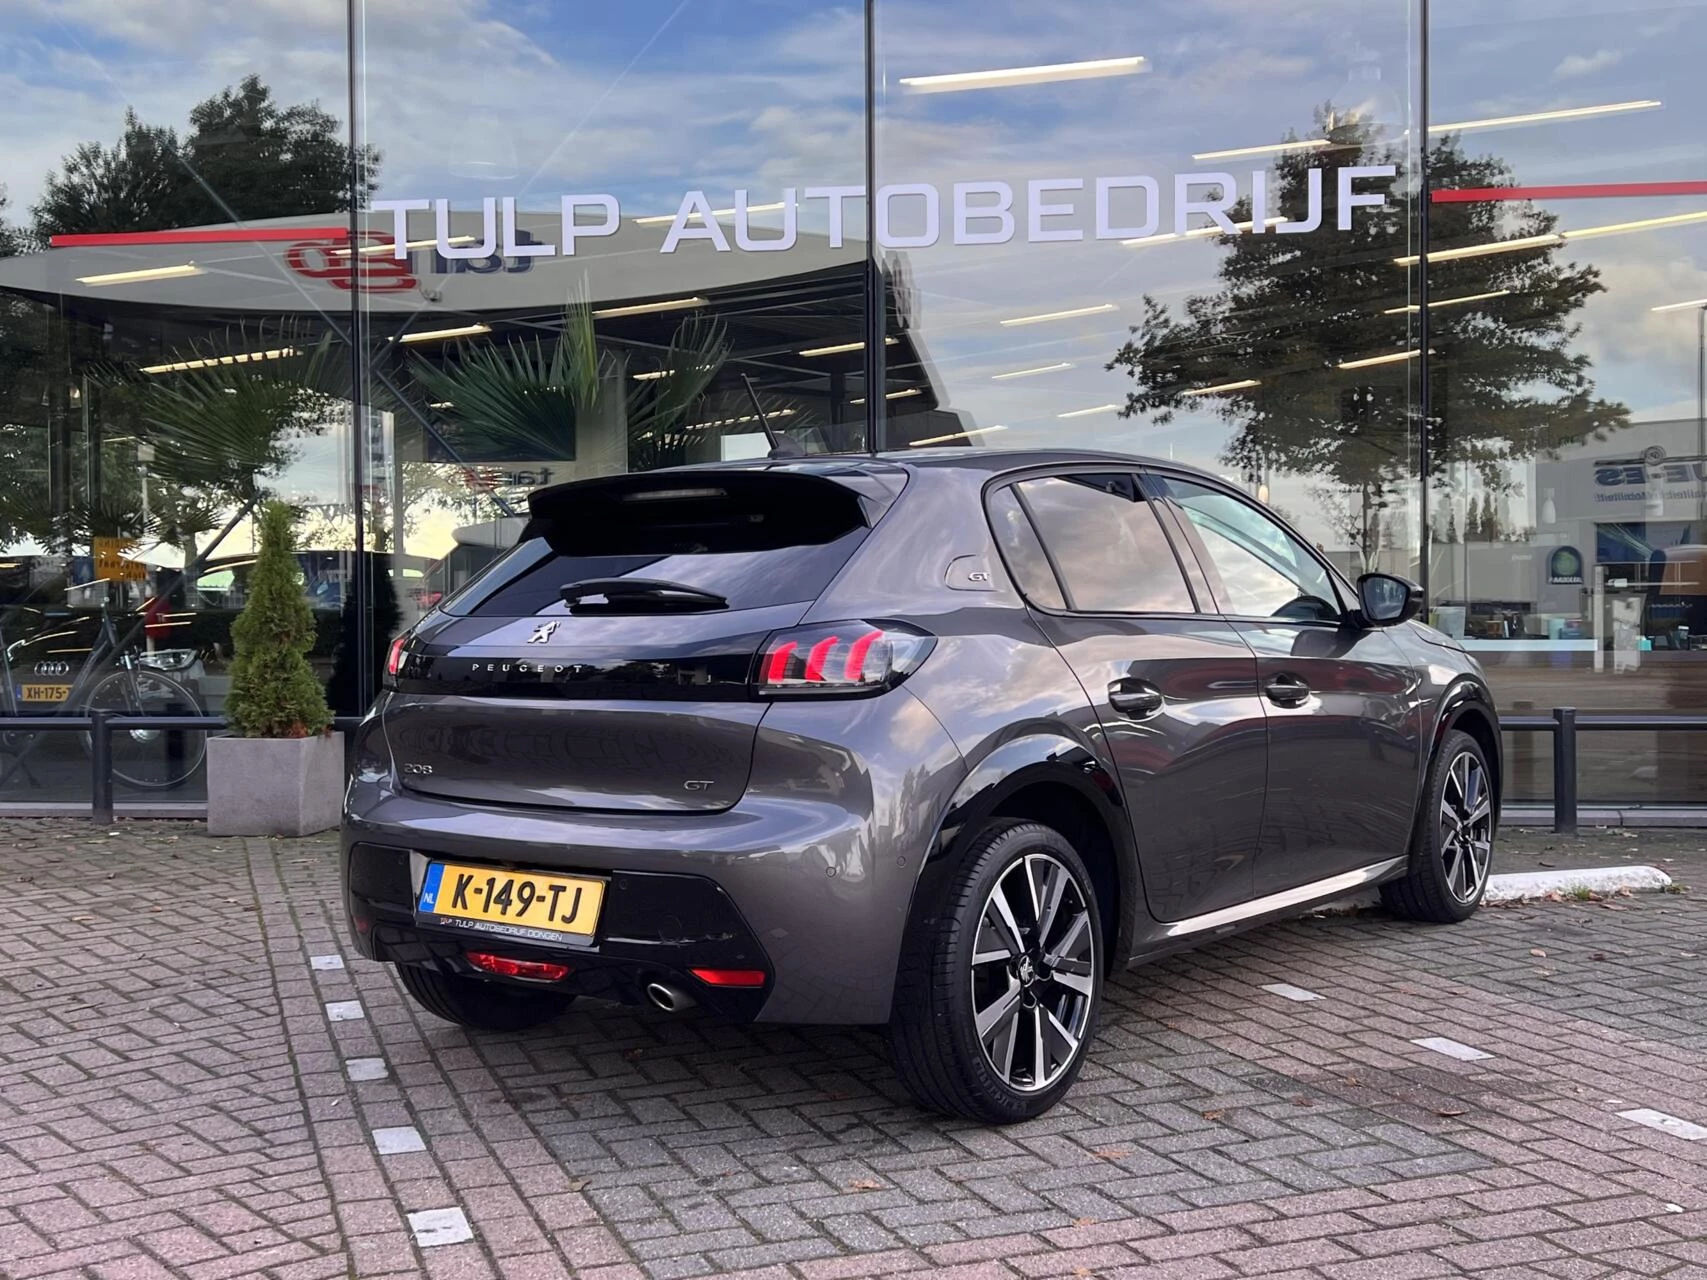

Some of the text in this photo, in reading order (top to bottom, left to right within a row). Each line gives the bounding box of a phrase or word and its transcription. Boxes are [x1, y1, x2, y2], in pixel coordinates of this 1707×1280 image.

[370, 165, 1397, 260] TULP AUTOBEDRIJF
[968, 571, 990, 581] GT
[472, 663, 582, 673] PEUGEOT
[404, 764, 433, 775] 208
[683, 780, 714, 791] GT
[423, 873, 582, 924] NL K-149-TJ
[455, 919, 474, 928] TULP
[527, 929, 563, 941] DONGEN
